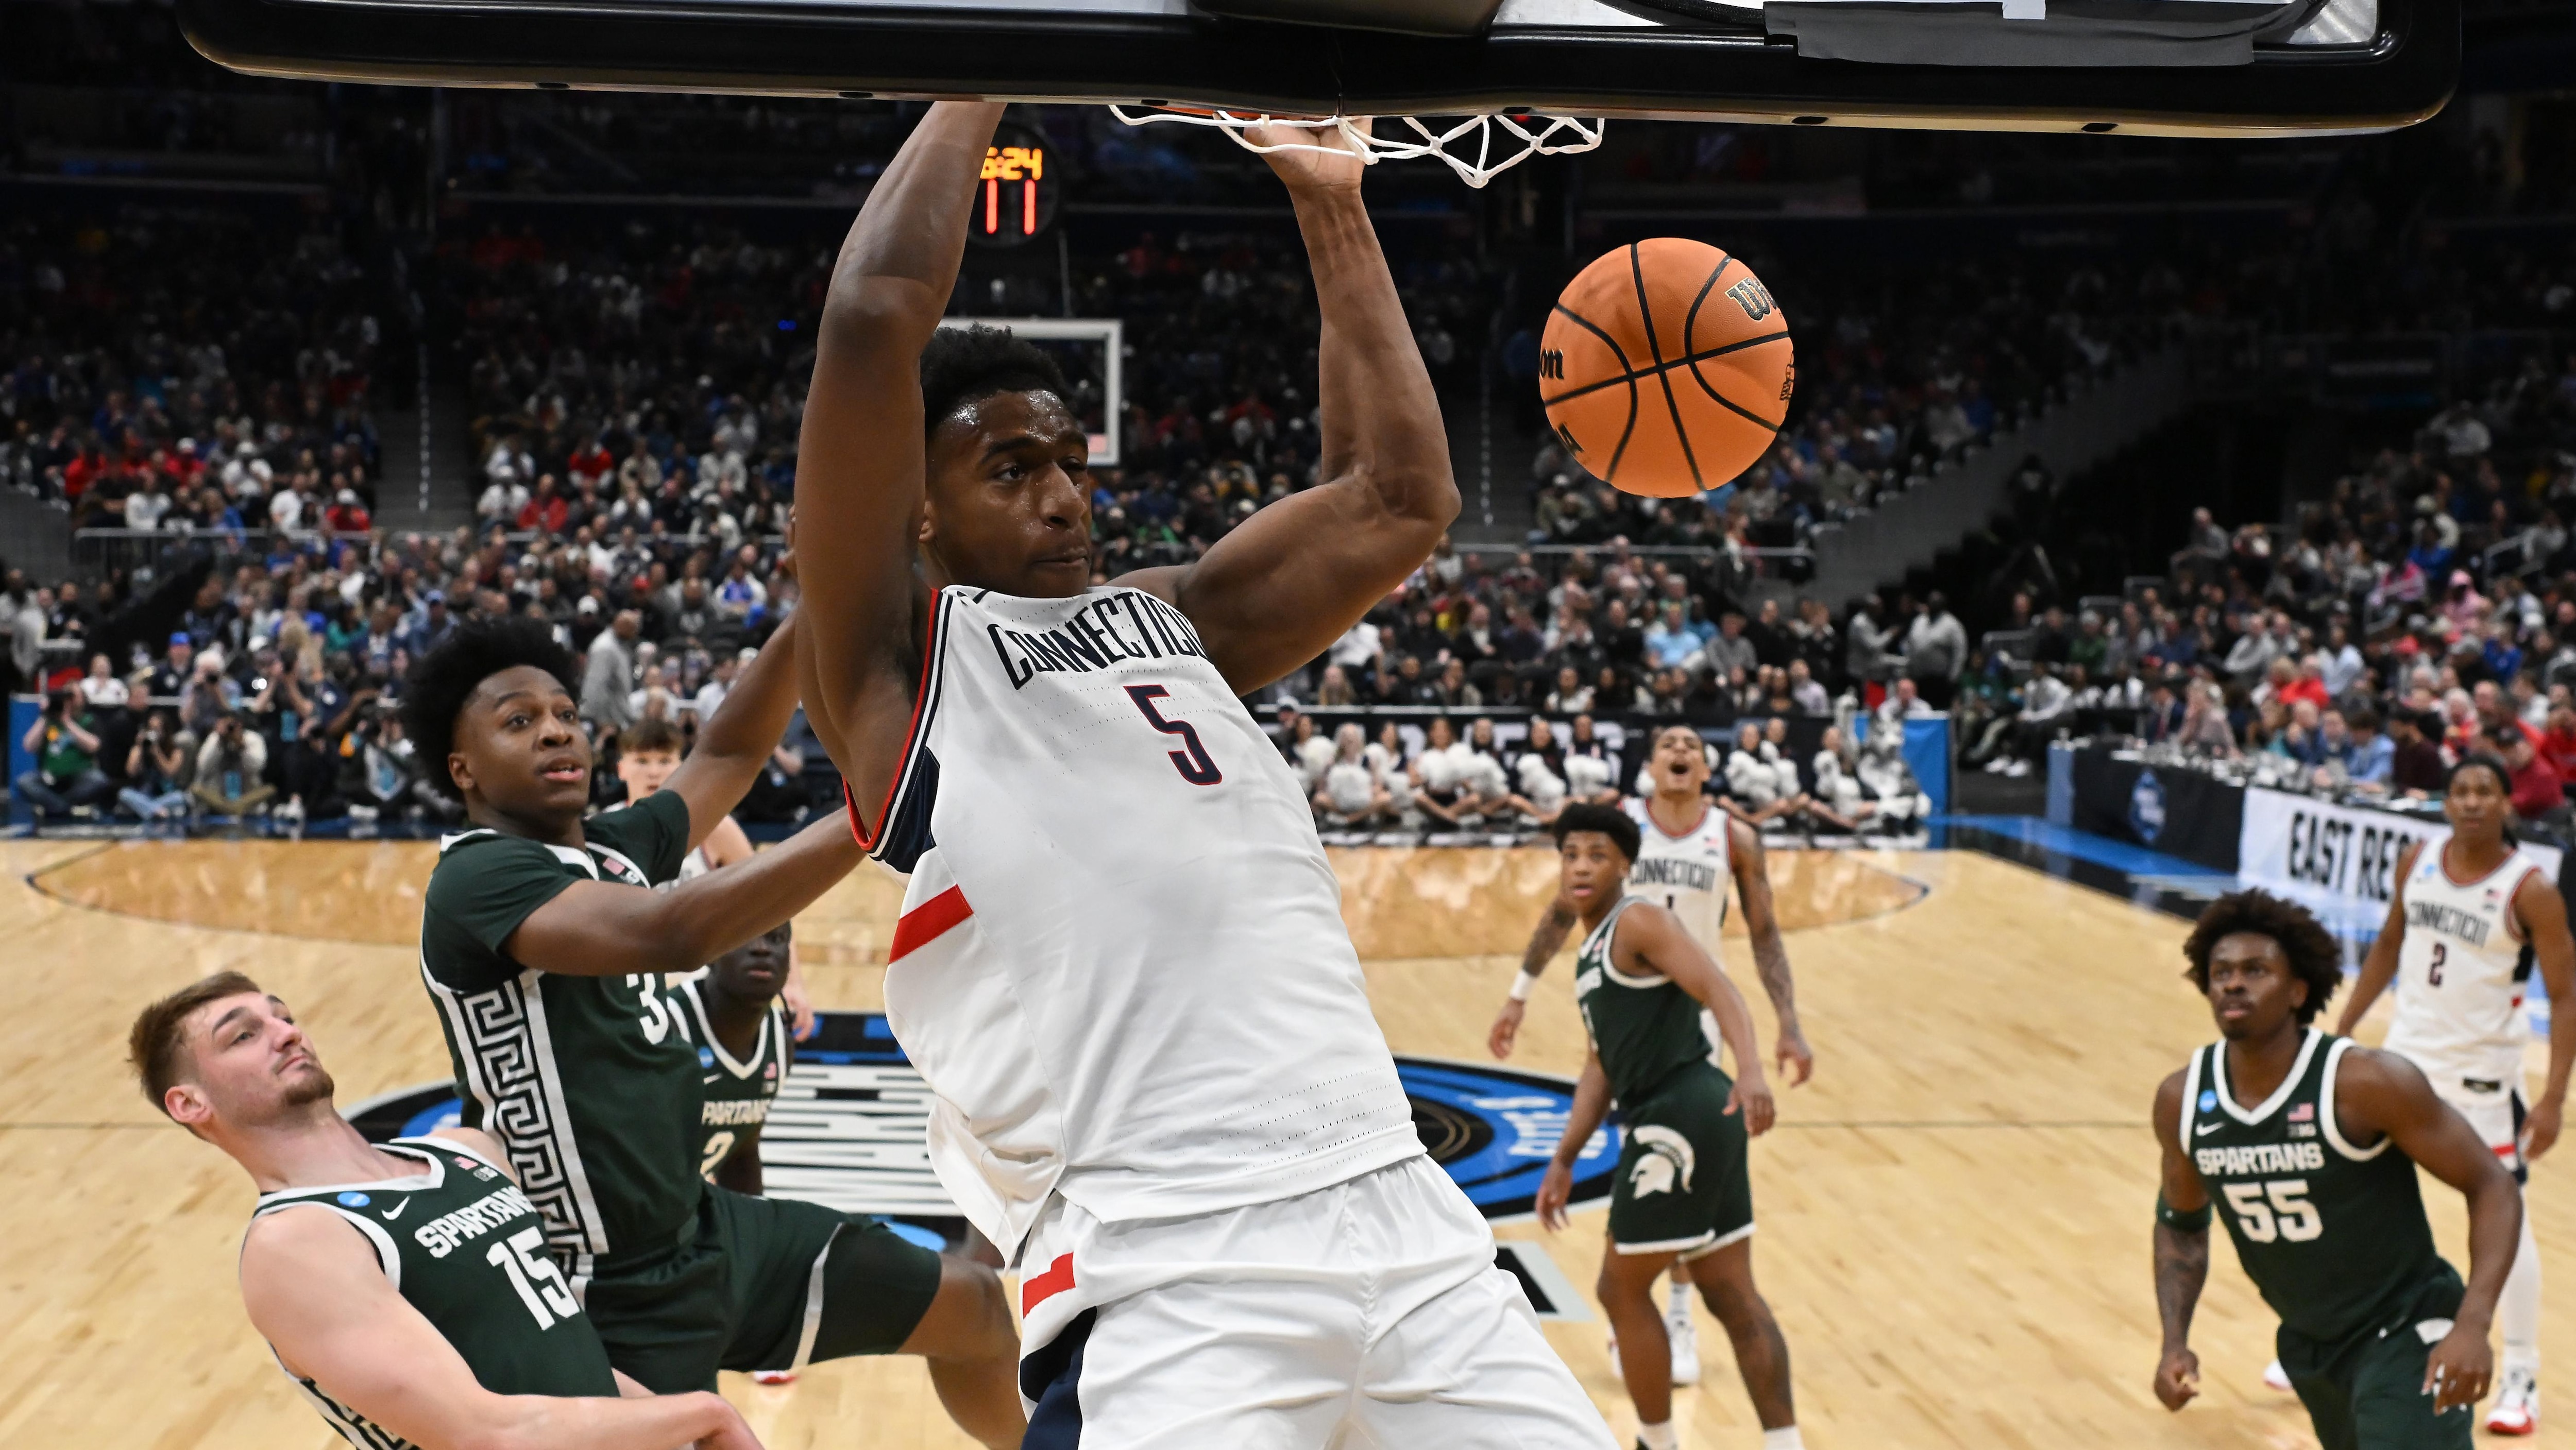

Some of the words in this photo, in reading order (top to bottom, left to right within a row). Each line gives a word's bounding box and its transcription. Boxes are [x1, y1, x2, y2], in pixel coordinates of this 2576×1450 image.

[986, 179, 1036, 235] 11
[1124, 684, 1223, 786] 5
[2289, 812, 2353, 892] EAST
[2428, 942, 2446, 987] 2
[627, 973, 669, 1045] 3
[2195, 1141, 2325, 1176] SPARTANS
[2222, 1179, 2323, 1243] 55
[486, 1225, 580, 1331] 15
